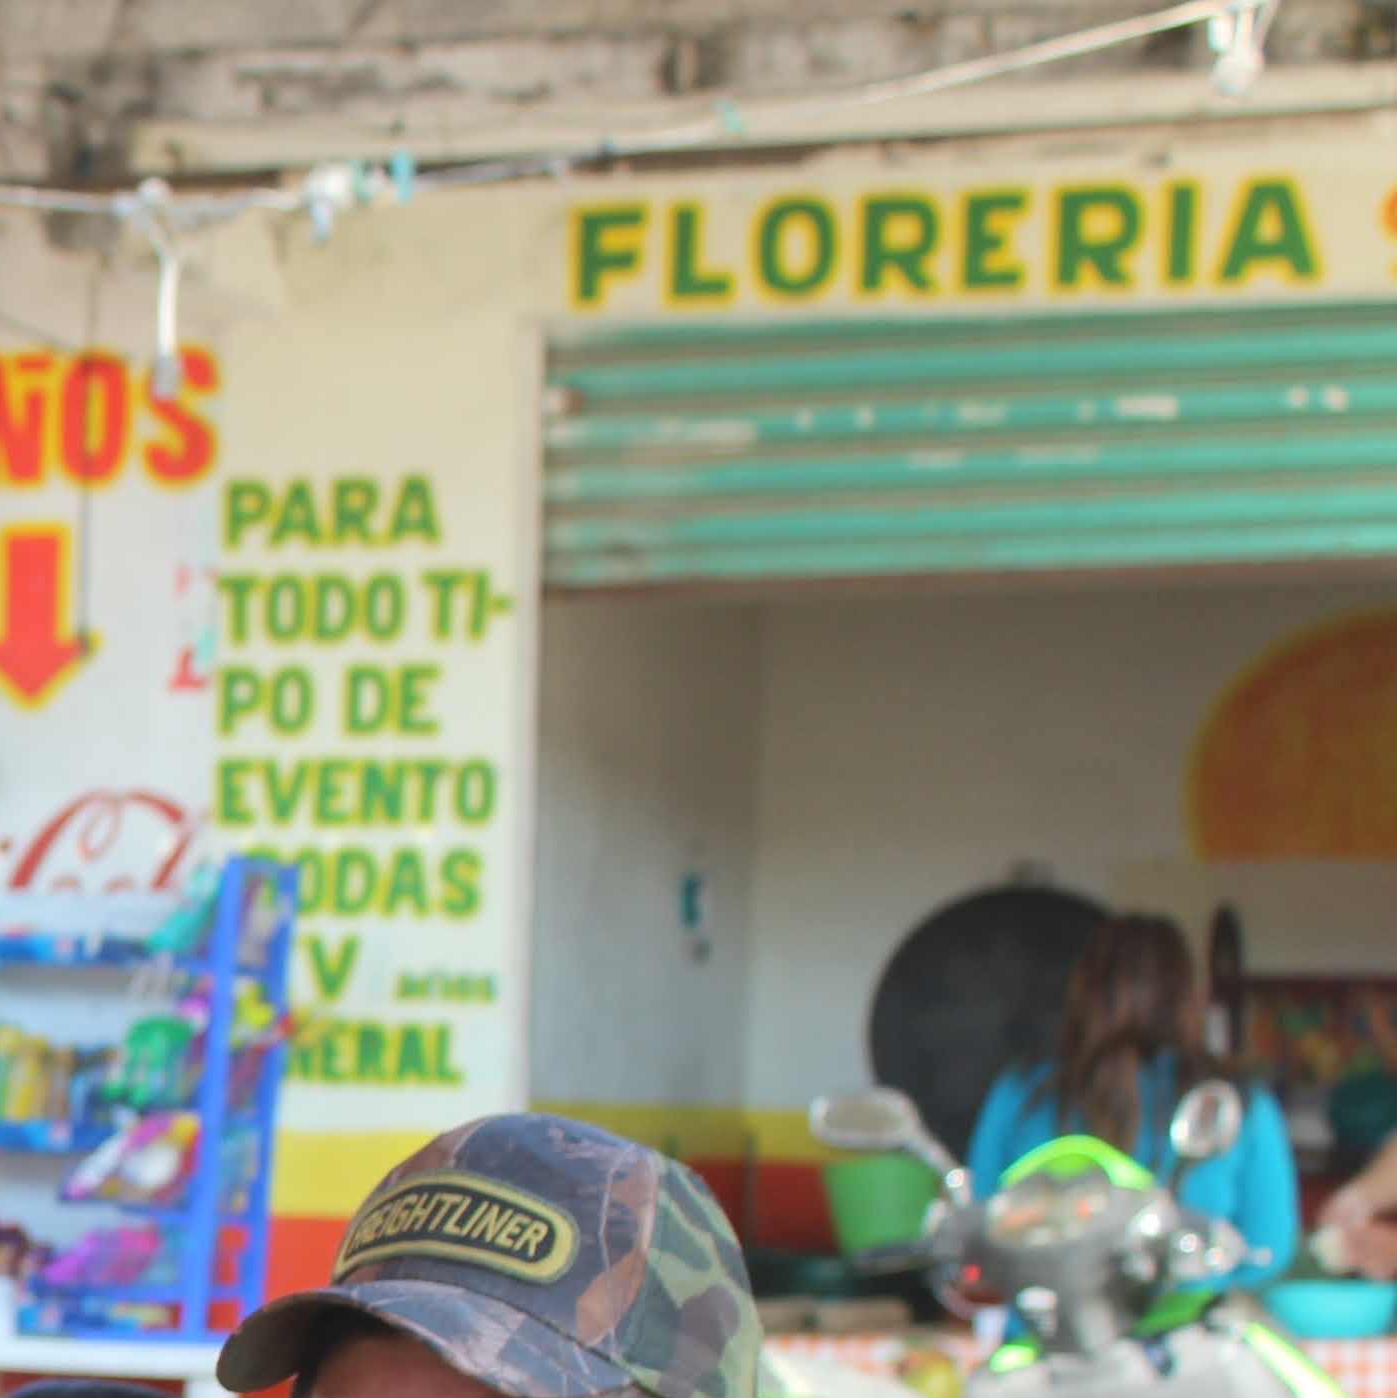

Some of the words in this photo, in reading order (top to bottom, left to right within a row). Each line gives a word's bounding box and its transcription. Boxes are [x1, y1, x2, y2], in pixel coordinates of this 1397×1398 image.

[572, 174, 1321, 306] FLORERIA
[224, 475, 442, 547] PARA
[216, 570, 406, 643] TODO
[215, 662, 315, 737] PO
[344, 661, 442, 736] DE
[215, 758, 497, 828] EVENTO
[245, 846, 484, 918] ODAS
[287, 1021, 465, 1084] NERAL
